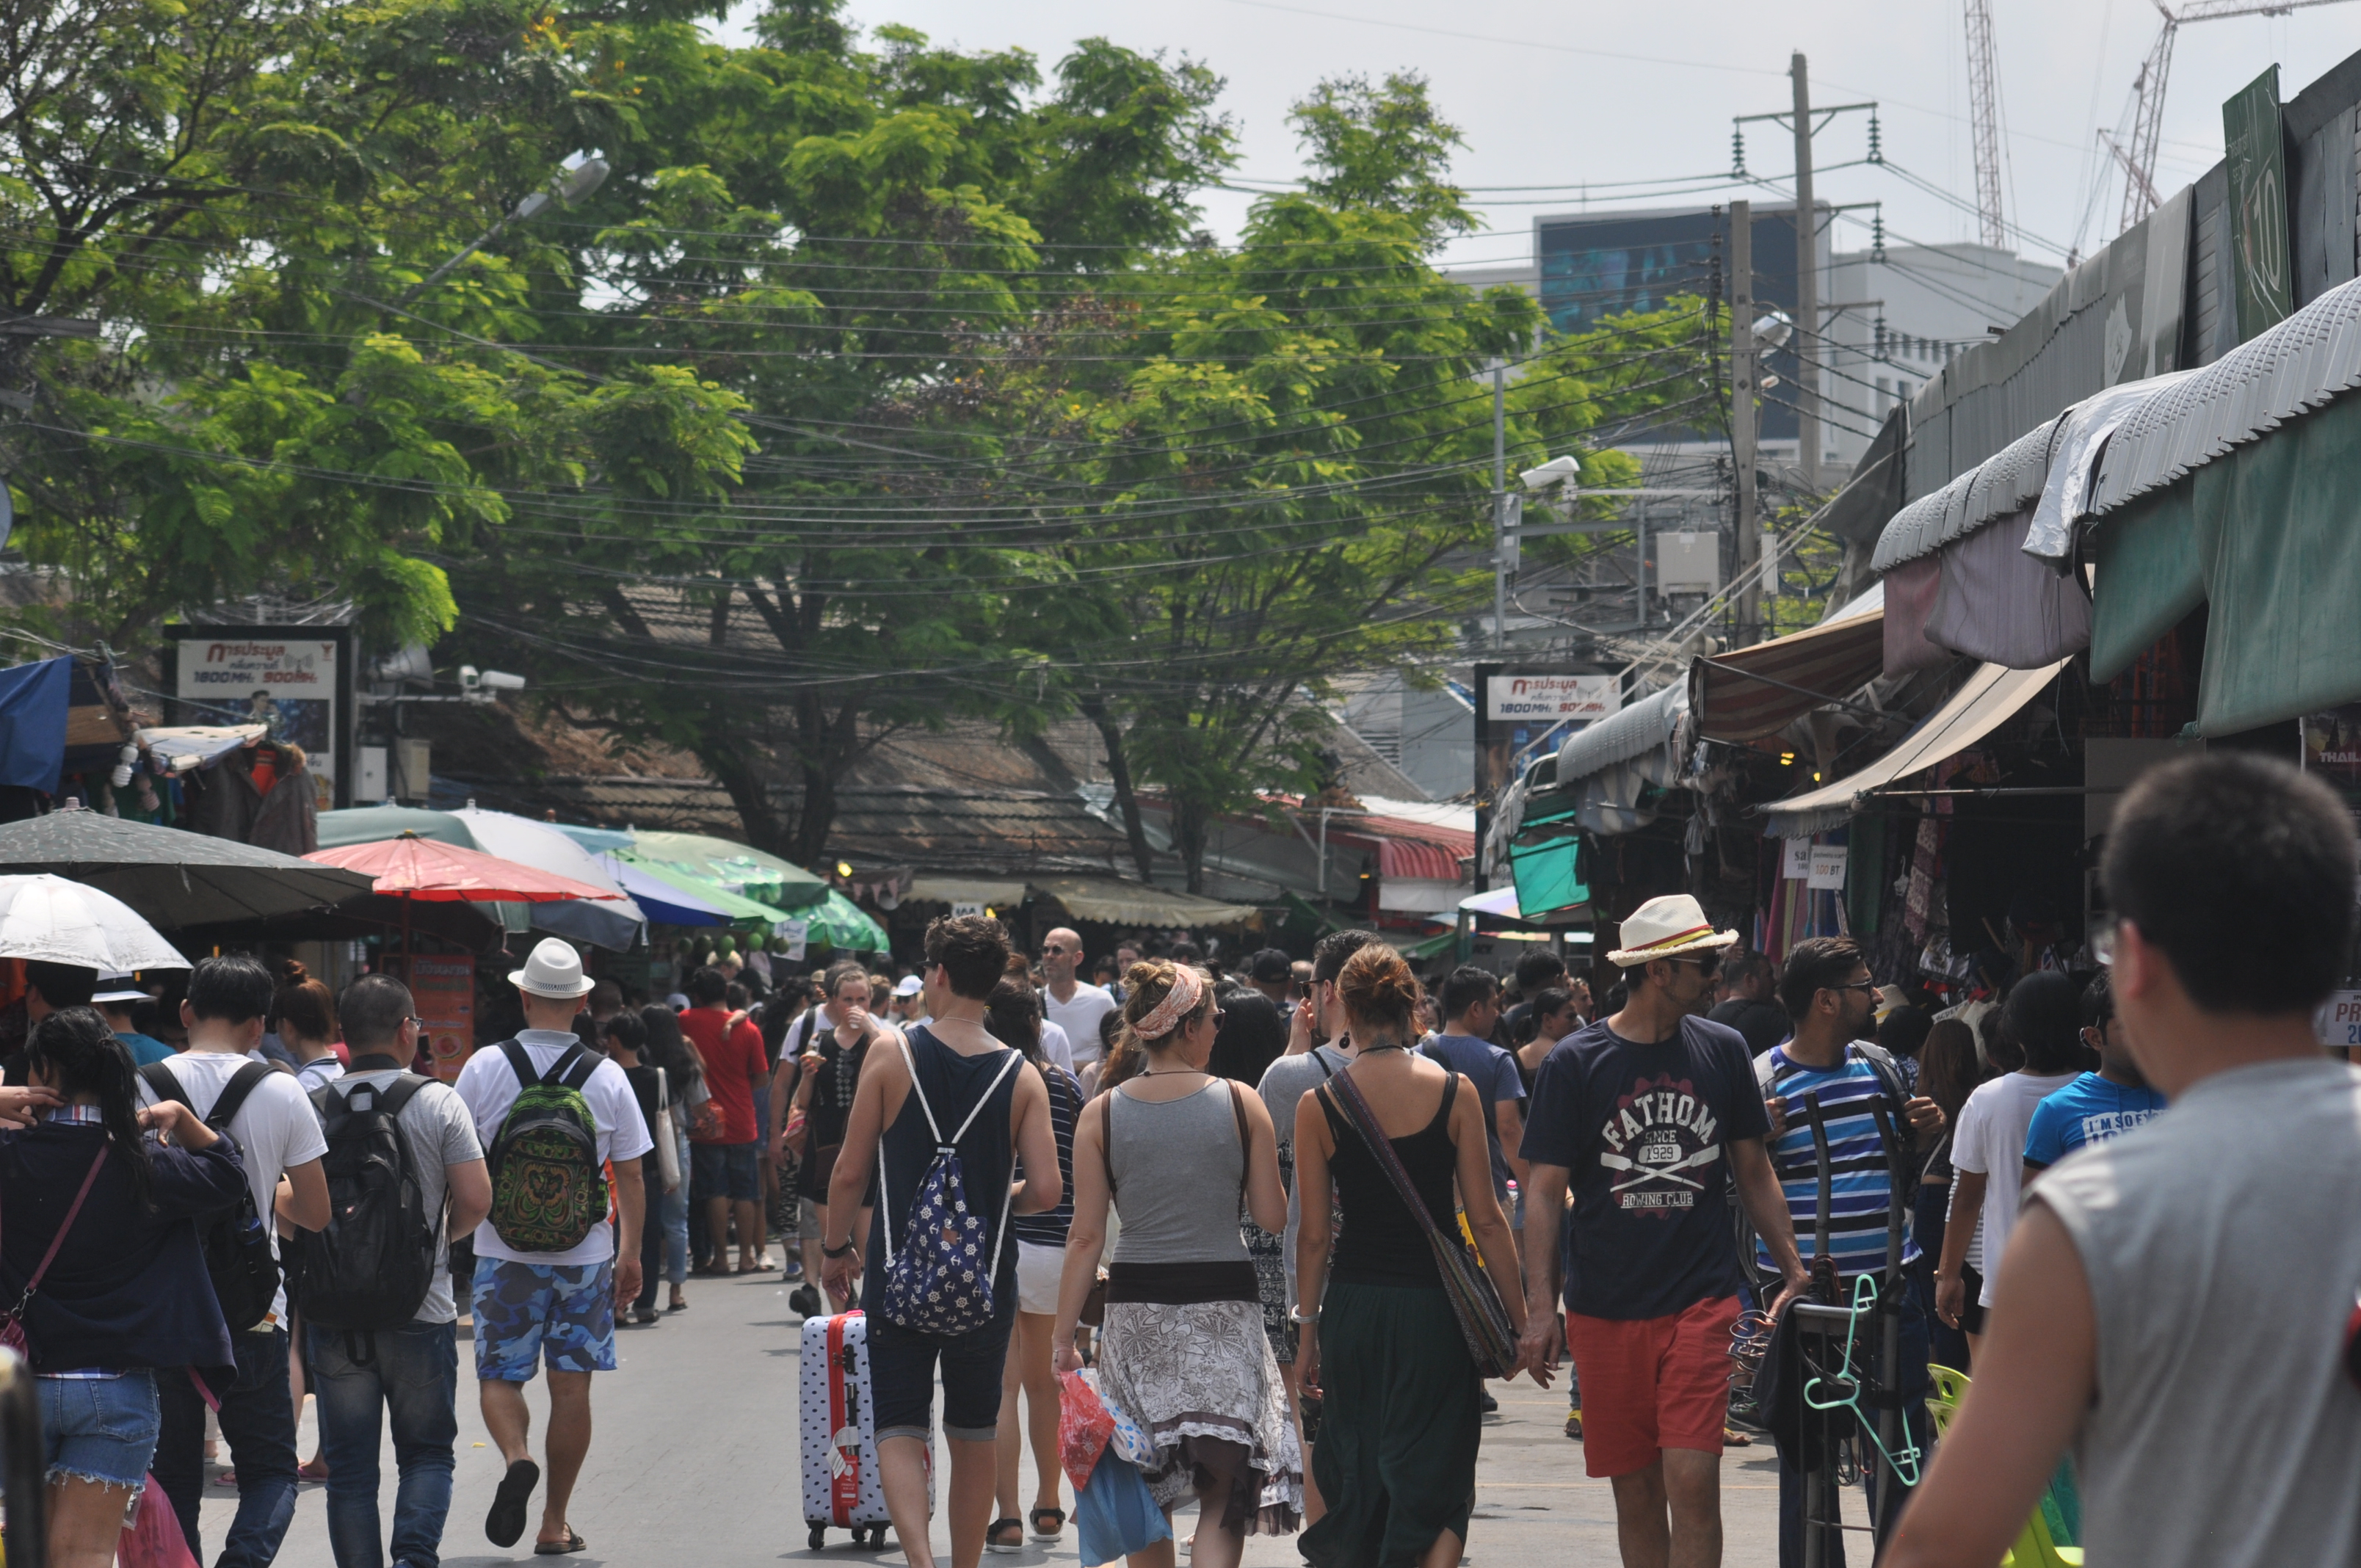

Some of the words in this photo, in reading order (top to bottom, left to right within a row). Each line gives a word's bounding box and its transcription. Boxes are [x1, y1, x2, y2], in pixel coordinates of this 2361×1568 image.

[2254, 169, 2280, 295] 10
[206, 642, 286, 663] การประมูล
[1512, 677, 1578, 695] การประมูล
[2319, 752, 2361, 763] THAIL
[1794, 850, 1808, 861] sa
[1816, 865, 1829, 875] 100
[1829, 865, 1840, 876] BT
[1601, 1092, 1717, 1153] FATHOM
[2115, 1114, 2133, 1128] SO
[1644, 1130, 1677, 1144] SINCE
[1647, 1147, 1674, 1161] 1929
[1622, 1193, 1662, 1207] ROWING
[1667, 1192, 1694, 1206] CLUB
